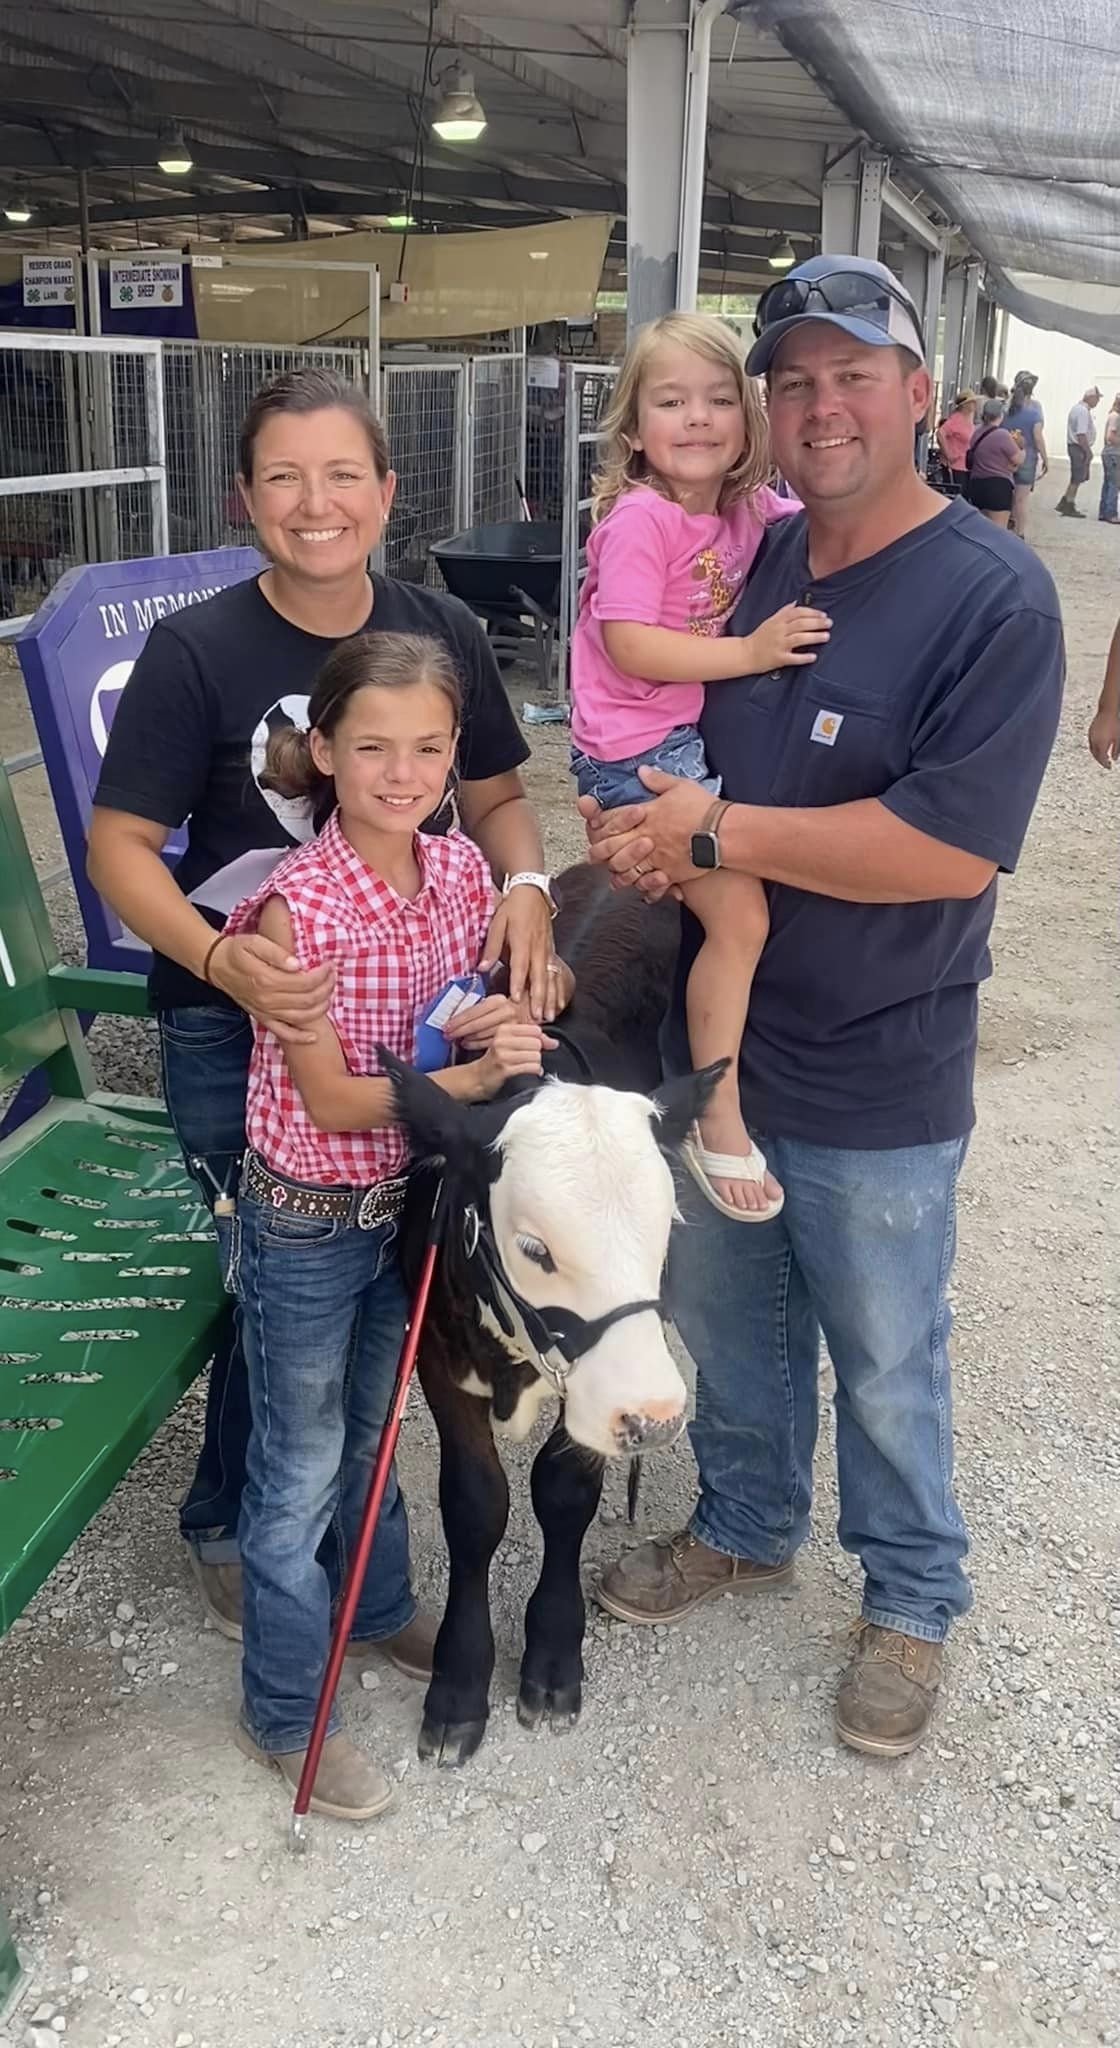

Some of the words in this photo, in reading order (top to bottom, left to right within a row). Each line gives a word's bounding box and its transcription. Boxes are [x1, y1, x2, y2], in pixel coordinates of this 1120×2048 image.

[29, 261, 52, 270] RESERVE
[53, 260, 71, 269] GRAND
[25, 276, 52, 286] CHAMPION
[113, 269, 151, 283] INTERMEDIATE
[152, 268, 180, 281] SHOWMAN
[137, 284, 155, 297] SHEEP
[99, 602, 129, 638] IN
[132, 585, 228, 632] MEM
